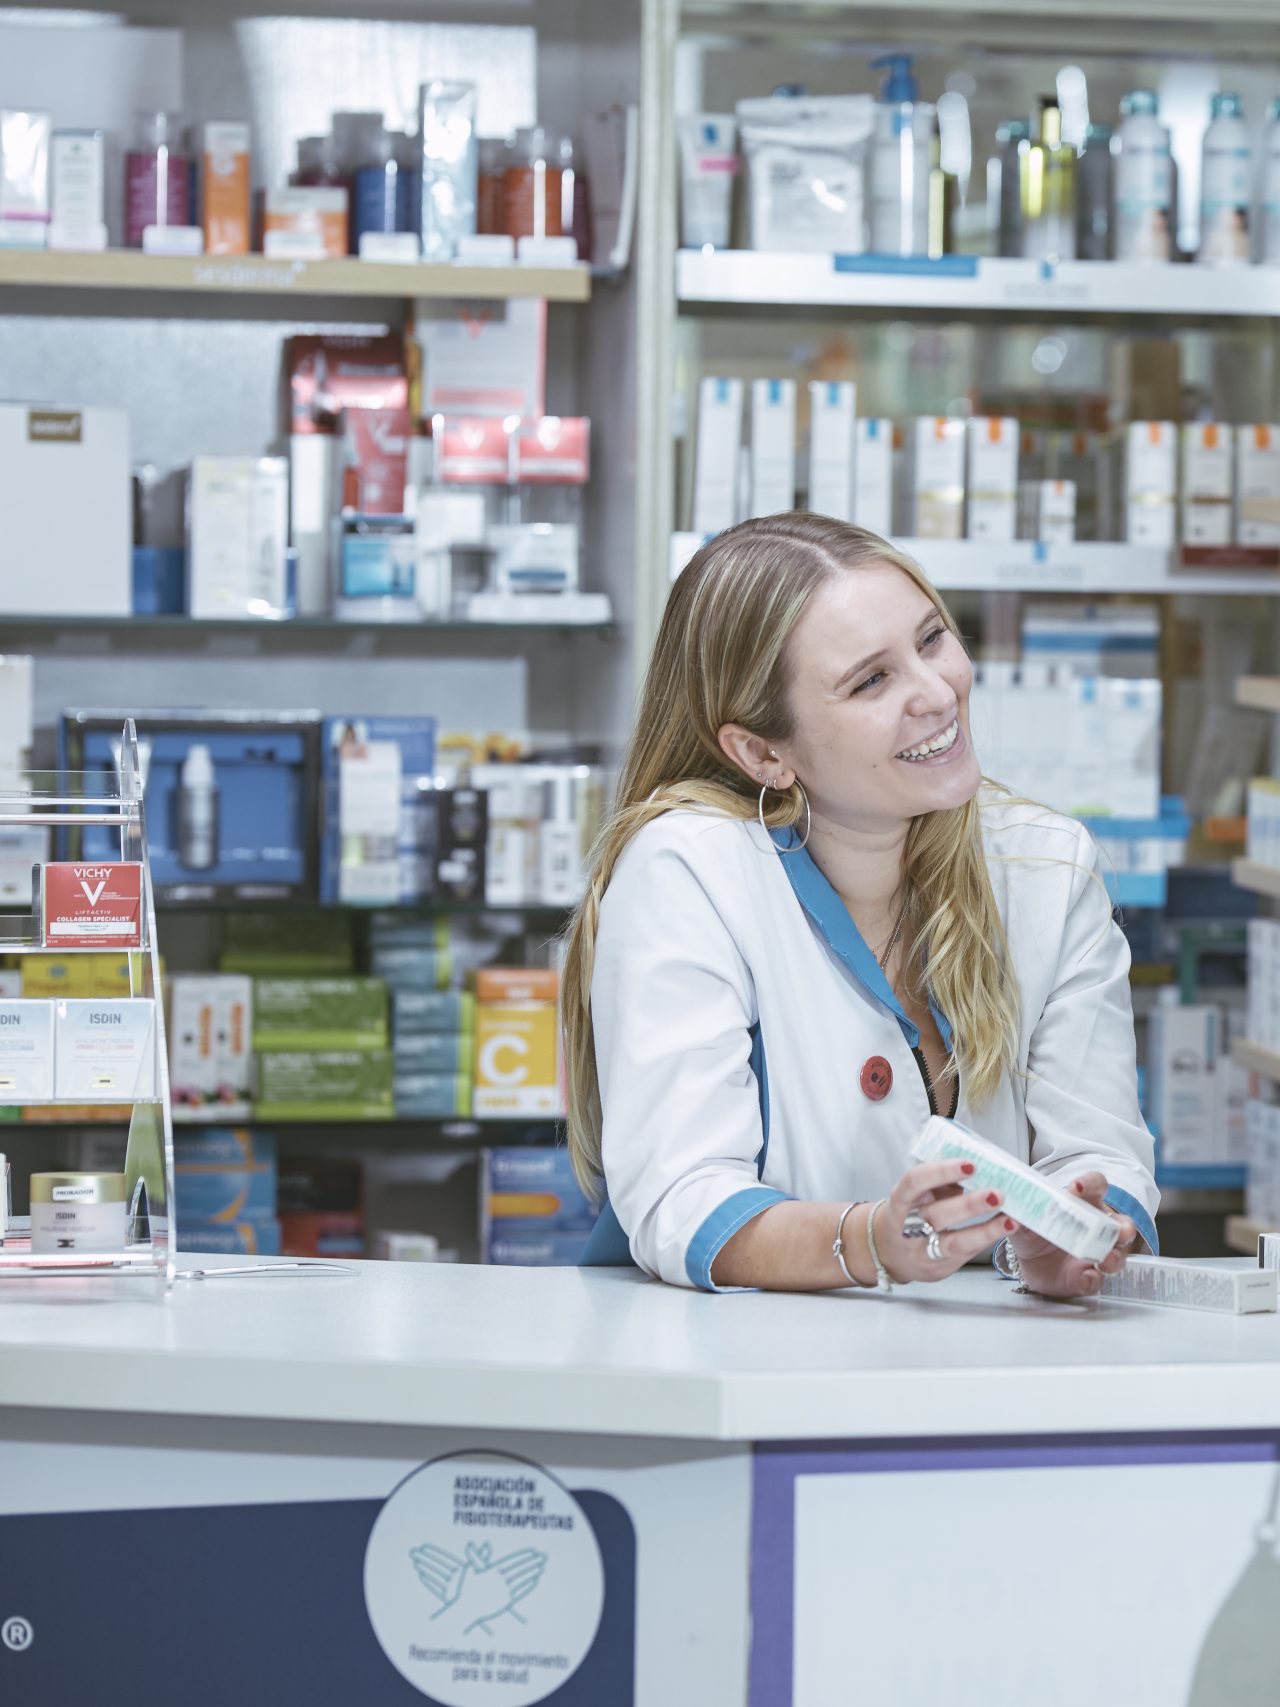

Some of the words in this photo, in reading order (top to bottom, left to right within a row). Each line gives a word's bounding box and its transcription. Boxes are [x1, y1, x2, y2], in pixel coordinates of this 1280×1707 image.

[73, 868, 112, 878] VICHY
[0, 1014, 21, 1025] DIN
[90, 1013, 122, 1024] ISDIN
[479, 1034, 529, 1085] C
[55, 1188, 94, 1196] PROBADOR
[55, 1212, 76, 1220] ISDIN
[454, 1475, 536, 1493] ASOCIACIÓN
[454, 1493, 523, 1511] ESPAÑOLA
[527, 1497, 544, 1512] DE
[454, 1511, 574, 1531] FISIOTERAPEUTAS
[409, 1645, 481, 1665] Recomienda
[485, 1651, 495, 1664] el
[499, 1653, 570, 1669] movimiento
[452, 1667, 479, 1682] para
[483, 1668, 492, 1681] la
[496, 1668, 529, 1684] salud
